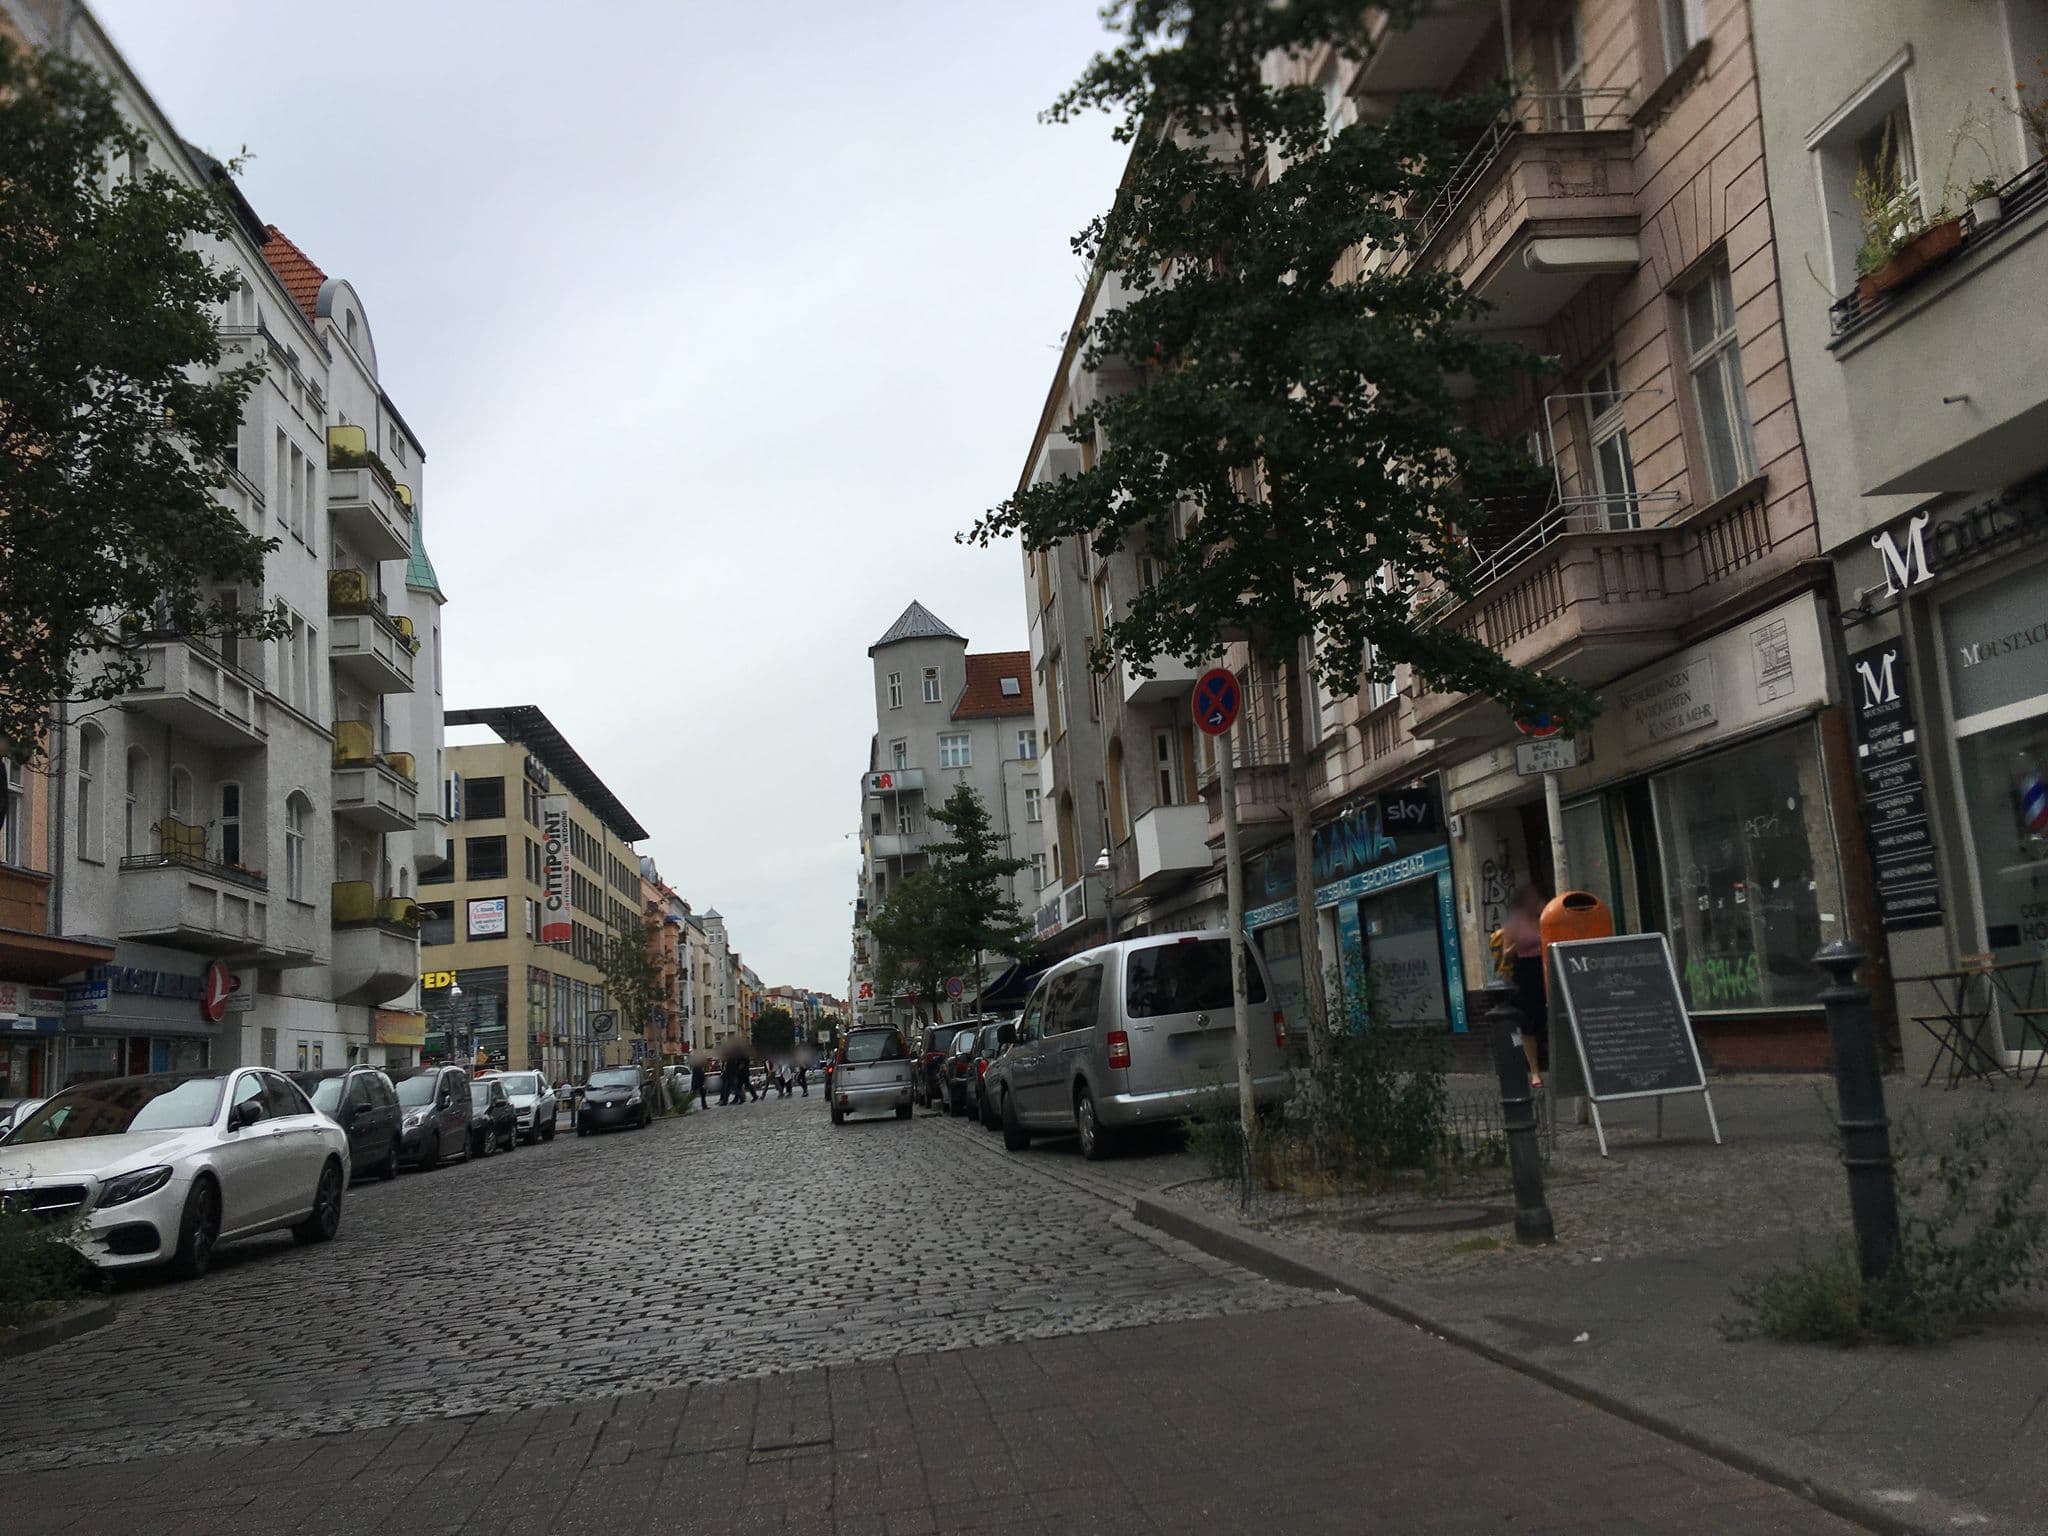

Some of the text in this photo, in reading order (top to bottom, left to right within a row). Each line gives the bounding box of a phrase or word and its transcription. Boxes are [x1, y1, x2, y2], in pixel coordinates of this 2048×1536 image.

[1960, 622, 2048, 668] MOUSTAC
[1856, 649, 1901, 710] M
[1387, 799, 1427, 824] sky
[1362, 855, 1424, 890] SPORTSBAR
[420, 971, 456, 989] EDi
